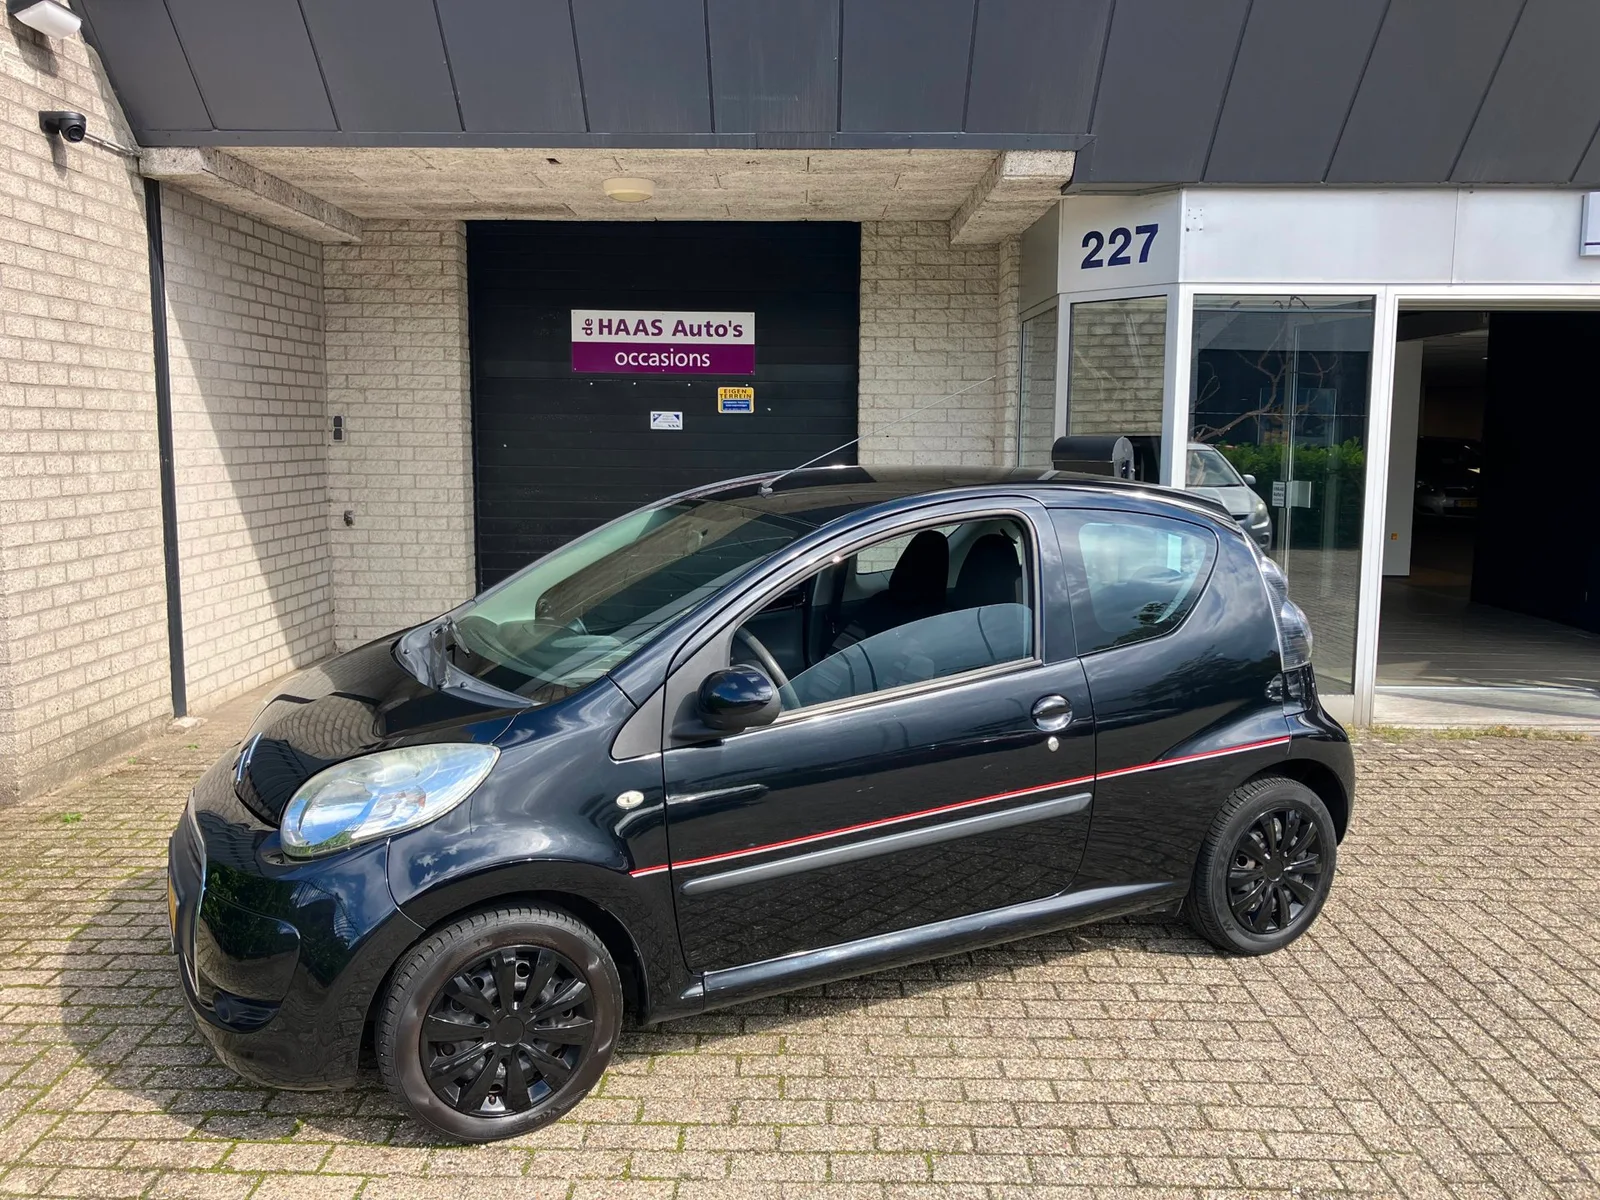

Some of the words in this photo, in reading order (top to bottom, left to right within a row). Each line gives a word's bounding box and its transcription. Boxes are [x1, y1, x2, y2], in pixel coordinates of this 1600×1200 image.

[1081, 223, 1159, 269] 227
[582, 318, 593, 336] de
[598, 318, 663, 337] HAAS
[671, 319, 743, 338] Auto's
[614, 348, 711, 367] occasions
